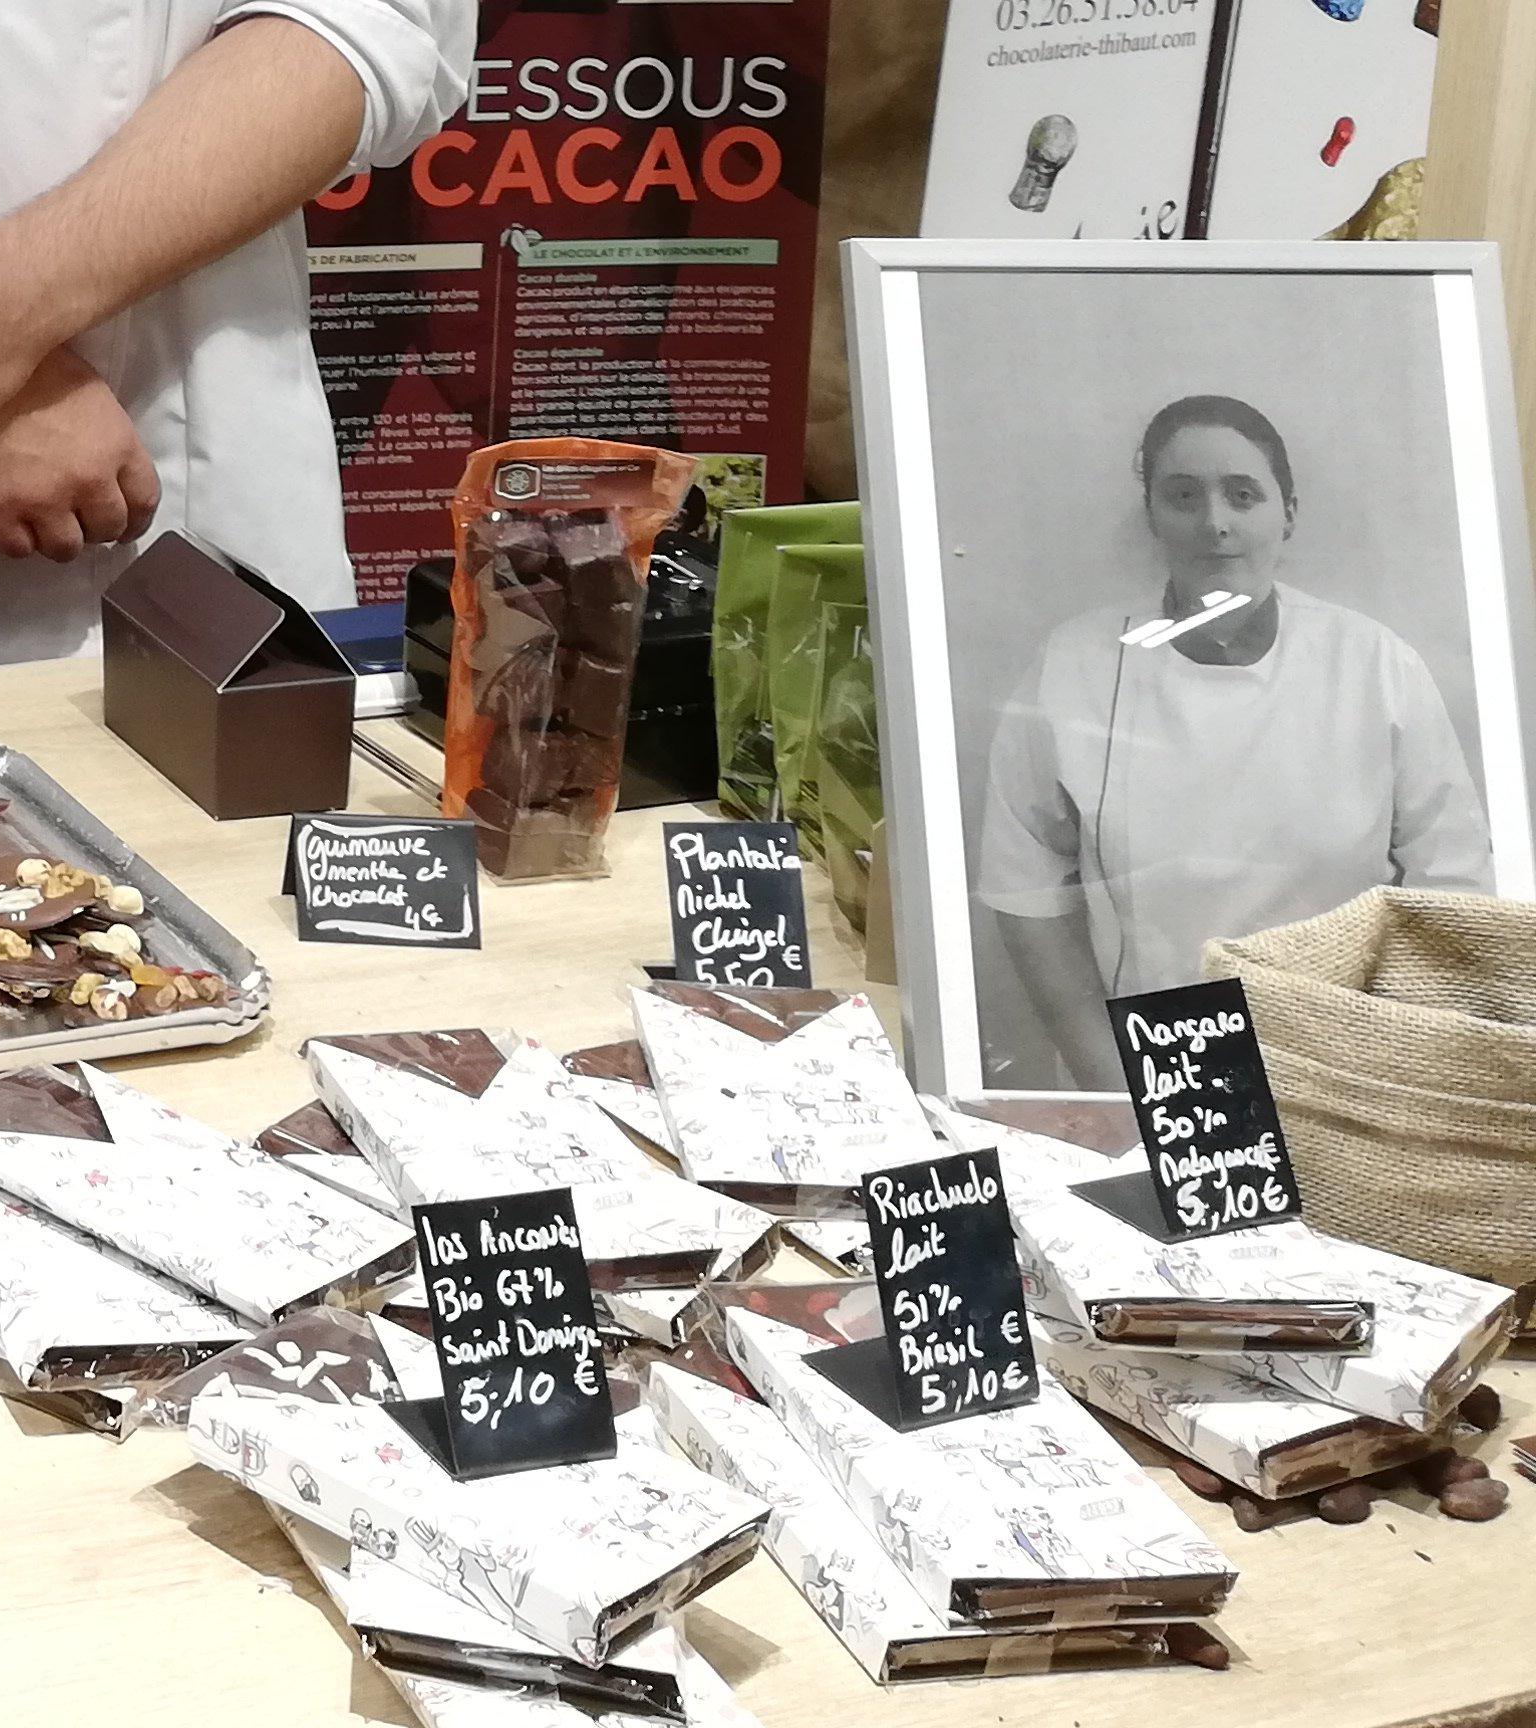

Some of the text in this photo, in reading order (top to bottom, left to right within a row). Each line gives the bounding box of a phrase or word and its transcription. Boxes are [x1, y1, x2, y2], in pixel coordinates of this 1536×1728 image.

[986, 28, 1197, 68] chocolaterie-thibaut.com
[411, 126, 782, 207] CACAO
[319, 253, 417, 266] DE FABRICATION
[533, 246, 750, 259] LE CHOCOLAT ET L'ENVIRONNEMENT
[432, 1276, 483, 1323] Bio
[441, 1319, 511, 1365] Saint
